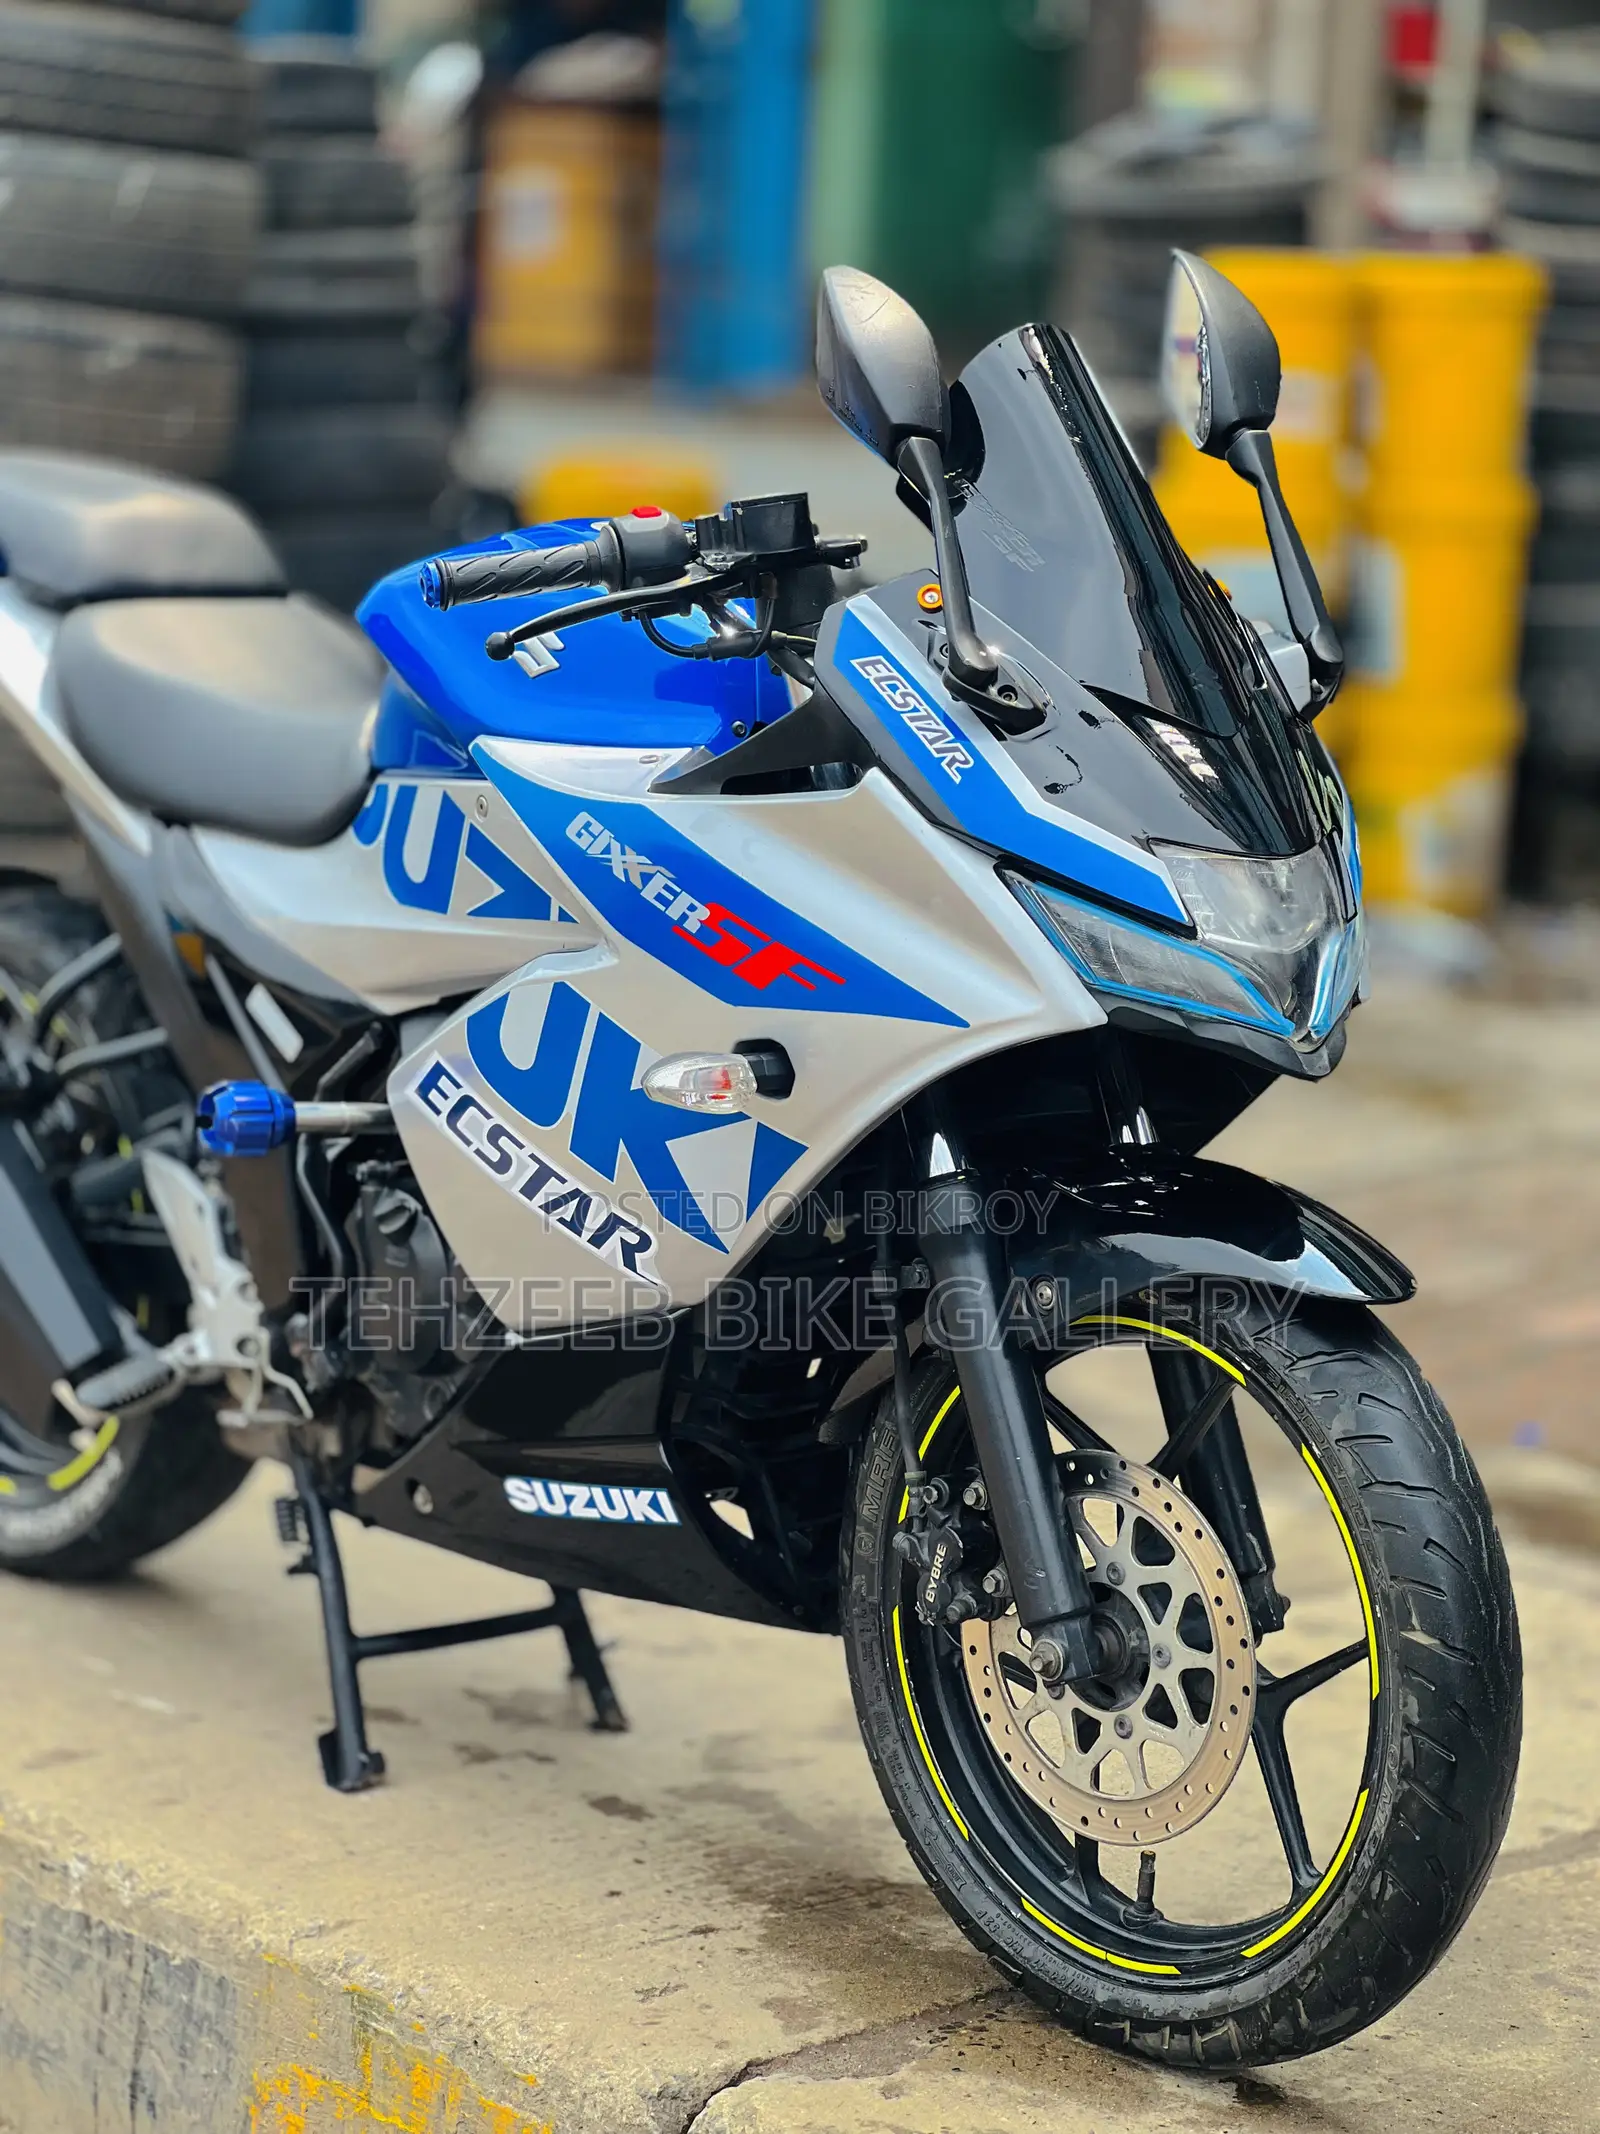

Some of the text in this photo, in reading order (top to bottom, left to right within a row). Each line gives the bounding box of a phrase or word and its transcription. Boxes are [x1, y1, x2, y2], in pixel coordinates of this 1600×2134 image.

[850, 655, 974, 784] ECSTAR
[565, 811, 847, 990] GIXXER SF
[413, 1058, 659, 1286] ECSTAR
[503, 1476, 680, 1524] SUZUKI
[861, 1426, 898, 1524] MRF
[925, 1543, 948, 1604] BYBRE
